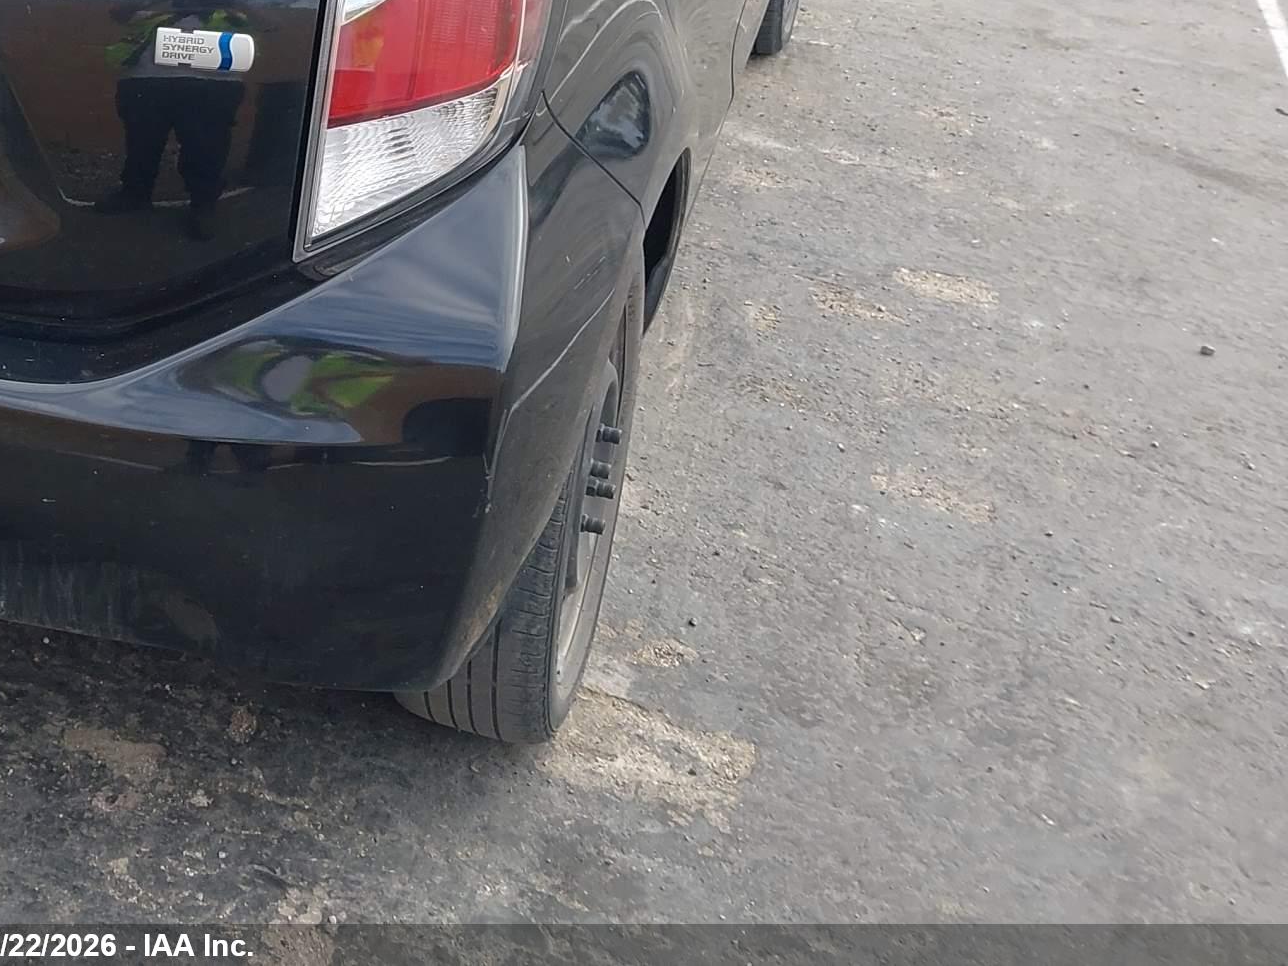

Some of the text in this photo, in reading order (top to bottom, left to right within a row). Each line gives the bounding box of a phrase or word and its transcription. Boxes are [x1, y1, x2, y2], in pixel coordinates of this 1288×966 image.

[163, 35, 205, 45] HYBRID
[162, 43, 214, 54] SYNERGY
[161, 51, 196, 61] DRIVE
